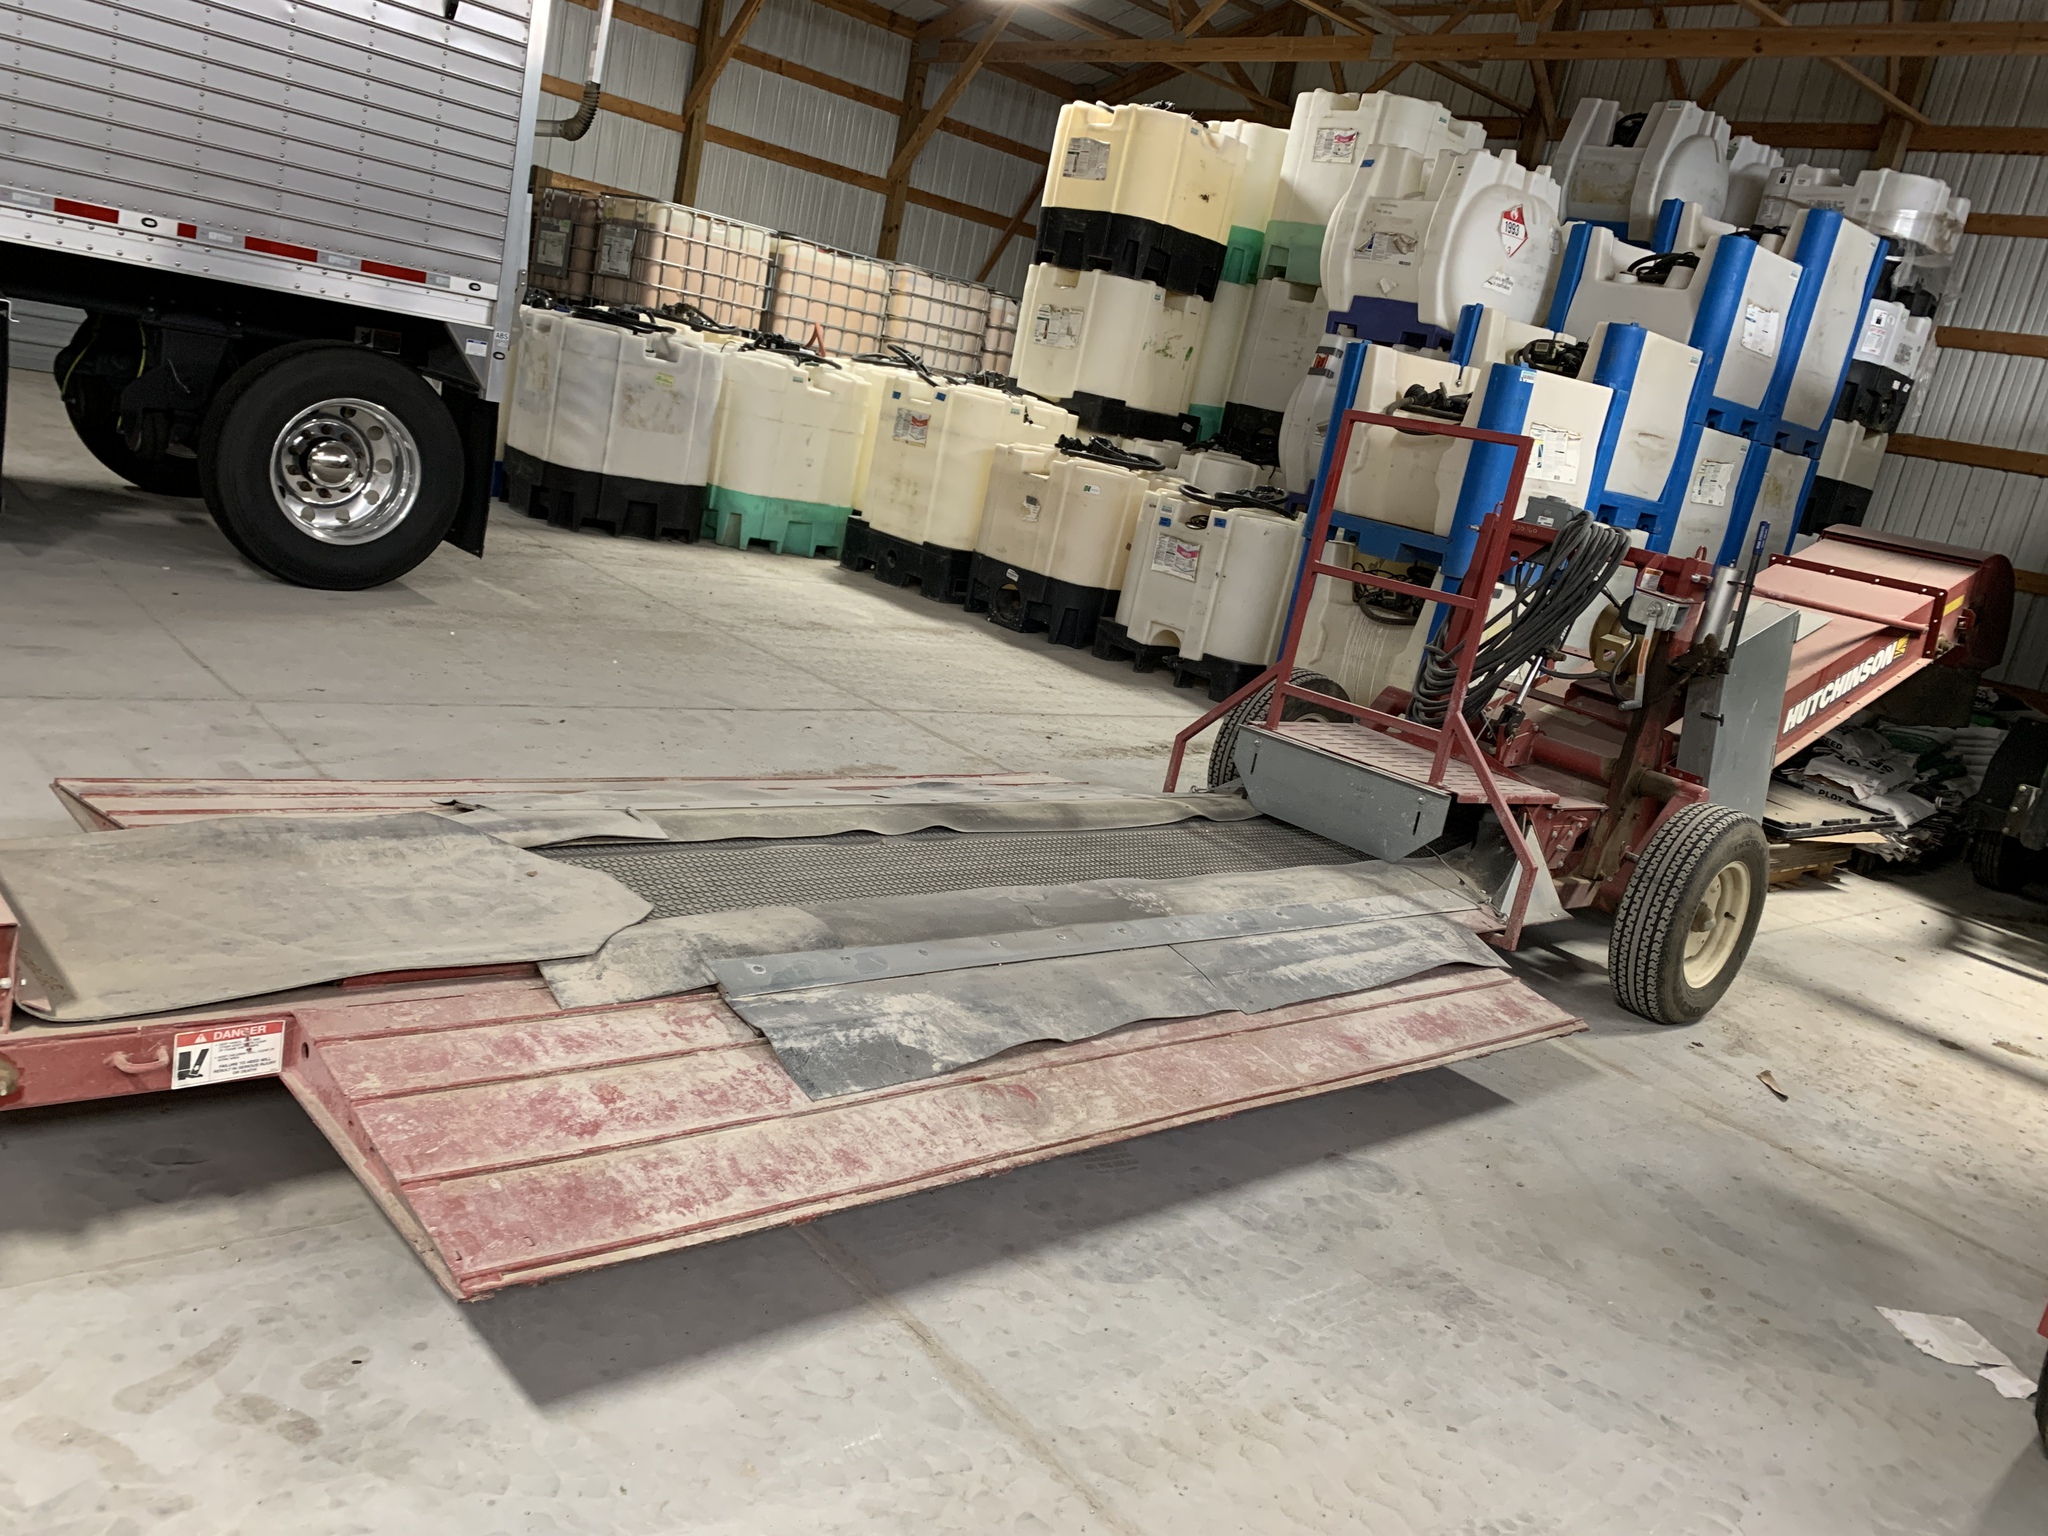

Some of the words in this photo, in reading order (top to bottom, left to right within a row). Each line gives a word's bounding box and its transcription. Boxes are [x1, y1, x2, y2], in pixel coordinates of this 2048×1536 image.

[1505, 221, 1520, 236] 1993
[1507, 246, 1512, 255] 3
[495, 332, 509, 340] ABS
[1782, 640, 1898, 734] HUTCHINSON
[1818, 789, 1844, 802] PLOT
[213, 1025, 267, 1040] DANGER
